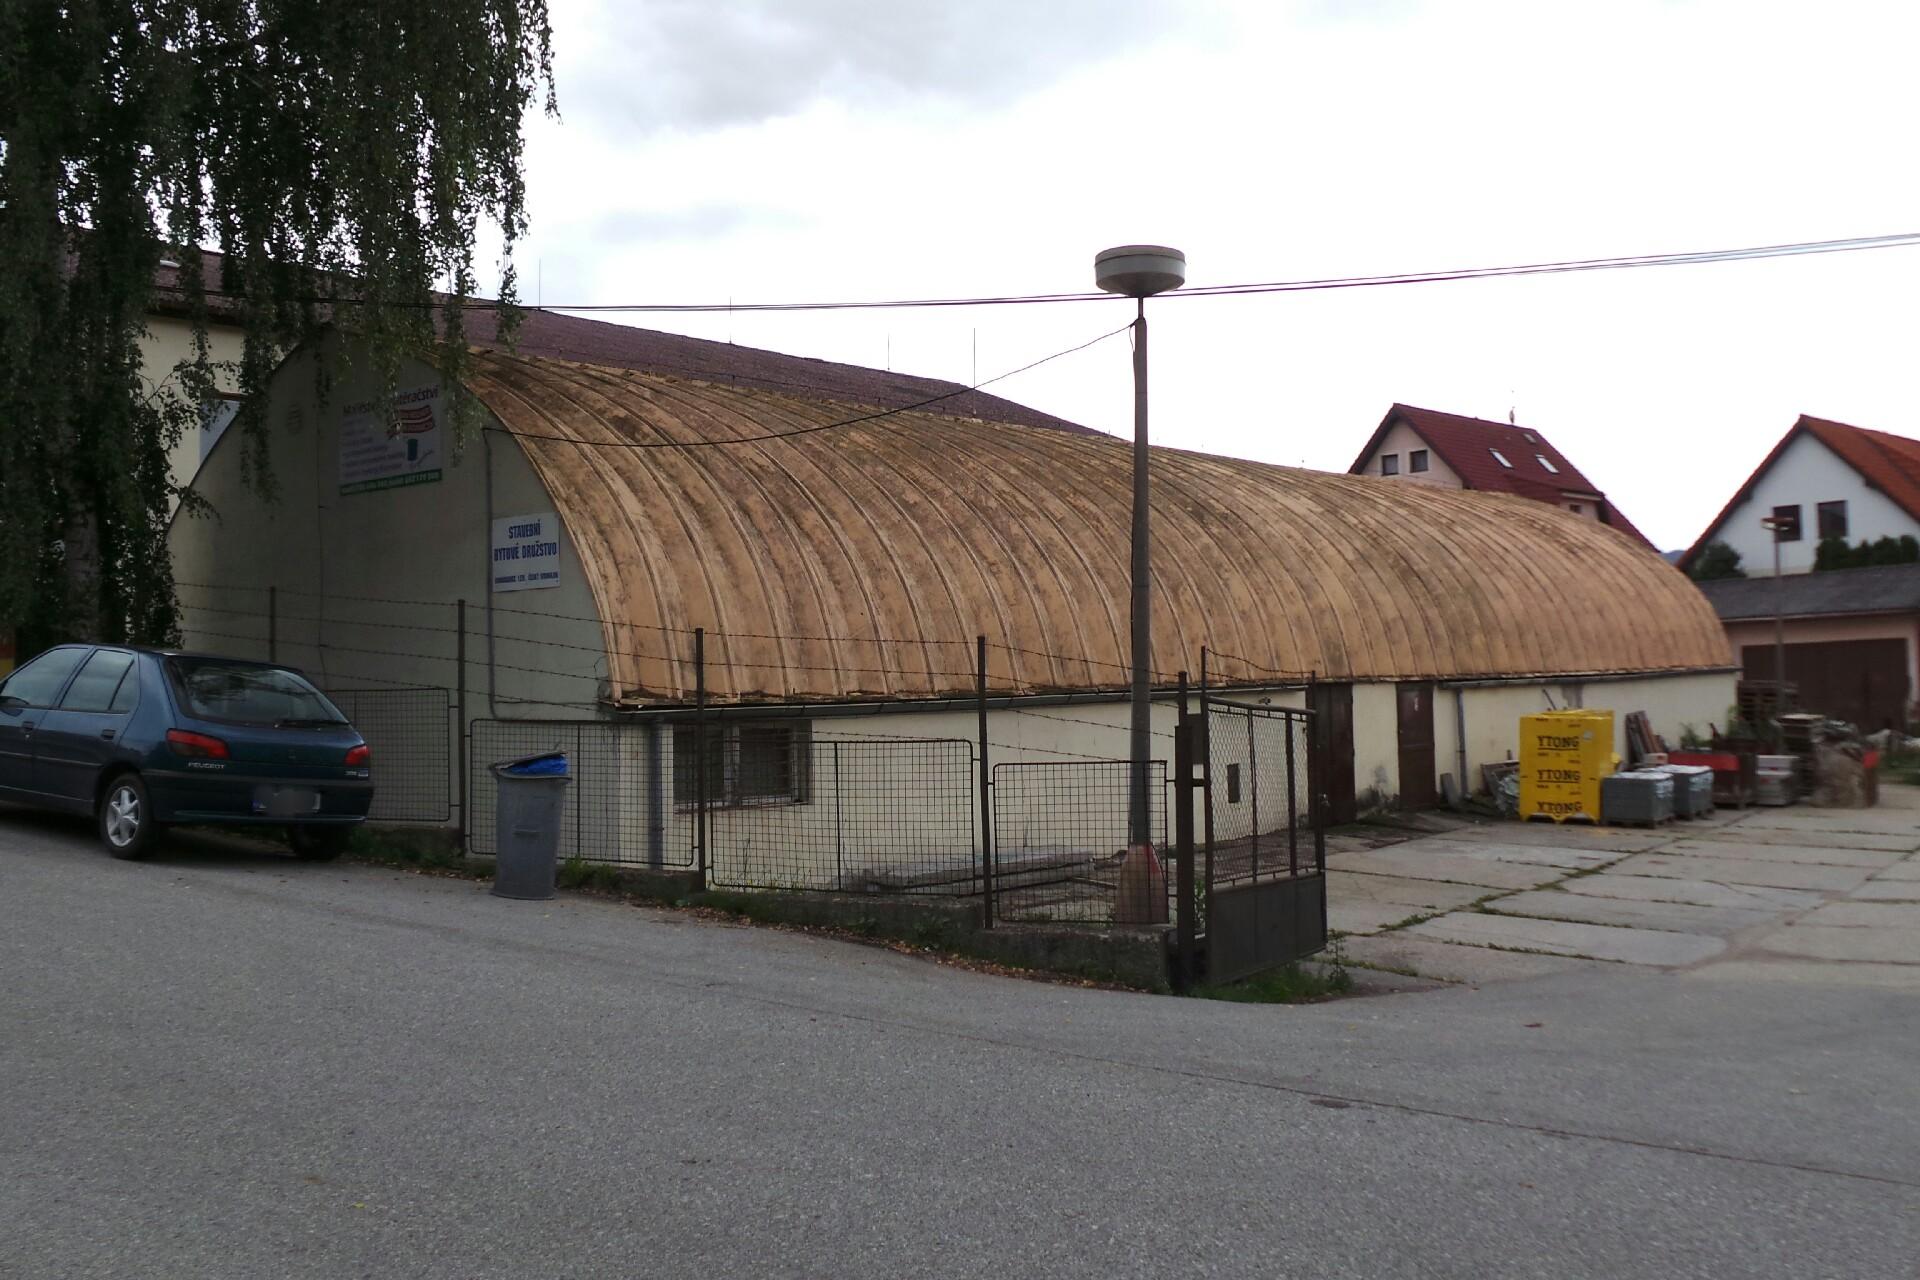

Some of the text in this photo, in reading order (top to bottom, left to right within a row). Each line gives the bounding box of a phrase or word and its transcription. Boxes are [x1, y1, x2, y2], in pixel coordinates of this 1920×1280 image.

[508, 519, 541, 538] STAVEBNÍ
[494, 540, 557, 561] BYTOVÉ DRUŽSTVO
[1537, 735, 1580, 748] YTONG
[1537, 769, 1580, 780] YTONG
[1537, 801, 1582, 812] YTONG
